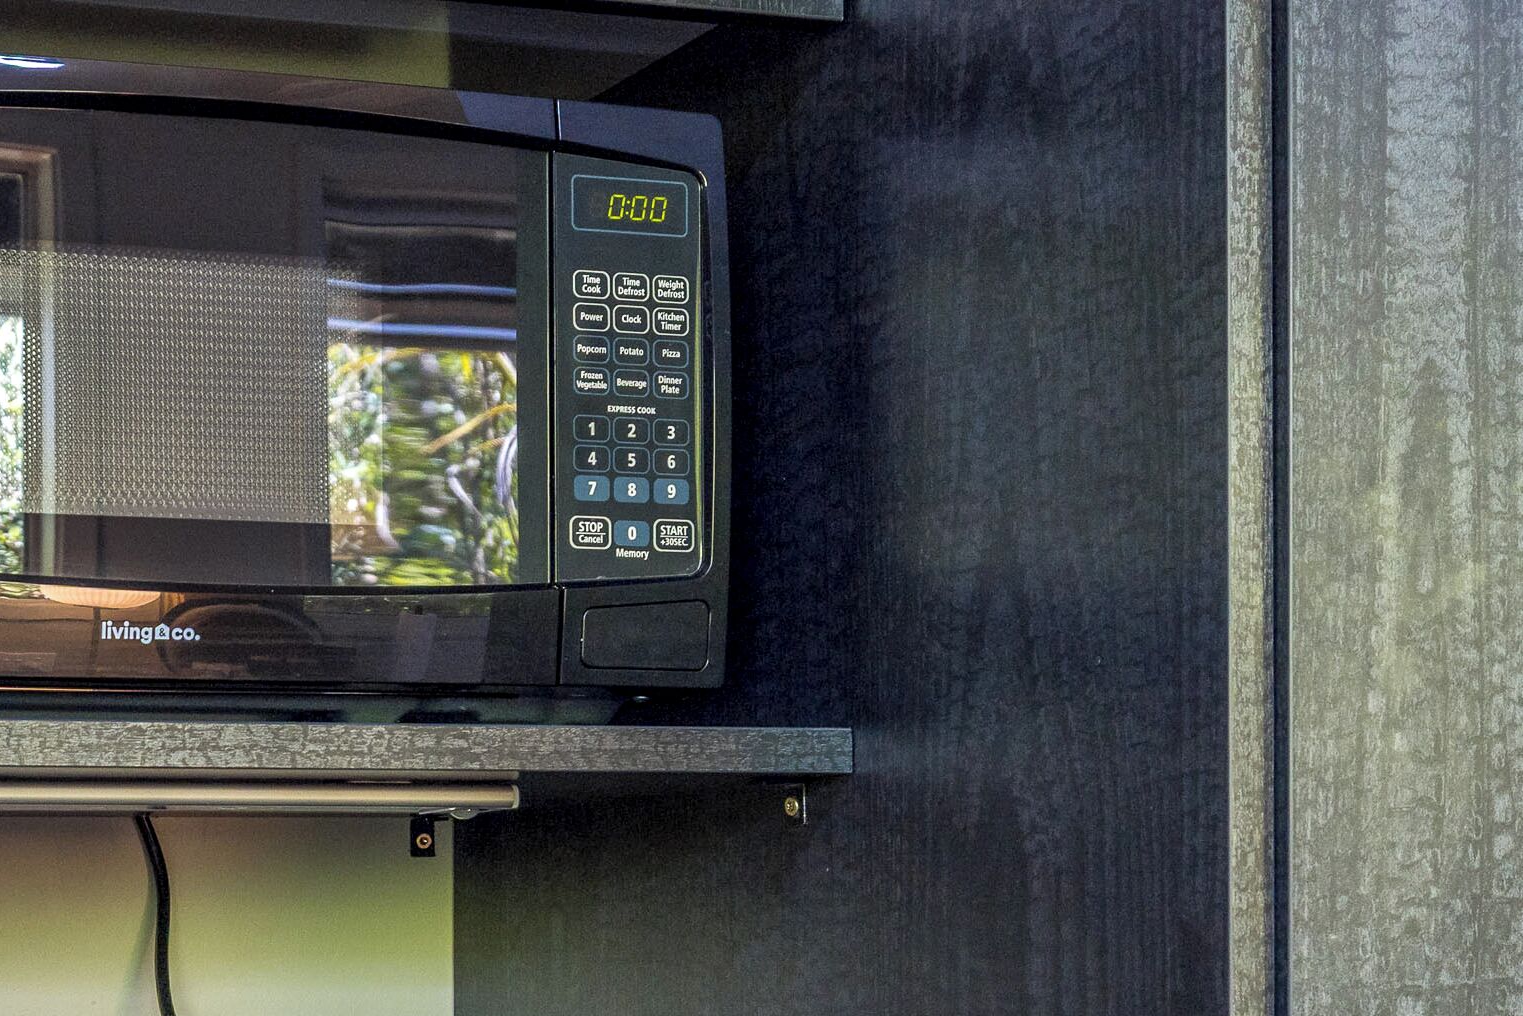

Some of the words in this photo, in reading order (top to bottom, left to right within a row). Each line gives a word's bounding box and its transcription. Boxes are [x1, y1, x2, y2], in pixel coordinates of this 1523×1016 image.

[608, 194, 668, 222] 0:00
[583, 274, 601, 284] Time
[622, 277, 641, 287] Time
[582, 284, 601, 294] Cook
[658, 280, 684, 291] Weight
[618, 286, 645, 297] Defrost
[657, 289, 685, 299] Defrost
[580, 312, 603, 321] Power
[621, 314, 642, 324] Clock
[657, 312, 685, 322] Kitchen
[660, 321, 682, 331] Timer
[577, 343, 607, 355] Popcorn
[619, 346, 644, 356] Potato
[662, 348, 681, 358] Pizza
[580, 370, 603, 380] Frozen
[658, 375, 683, 386] Dinner
[576, 380, 608, 390] Vegetable
[616, 378, 647, 390] Beverage
[661, 385, 680, 394] Plate
[607, 405, 636, 414] EXPRESS
[637, 406, 656, 415] COOK
[588, 422, 595, 436] 1
[627, 423, 636, 438] 2
[667, 425, 676, 440] 3
[588, 451, 597, 466] 4
[627, 453, 636, 467] 5
[667, 454, 676, 469] 6
[588, 481, 597, 495] 7
[627, 482, 637, 497] 8
[667, 484, 676, 499] 9
[578, 521, 604, 533] STOP
[660, 525, 689, 536] START
[578, 534, 603, 544] Cancel
[627, 526, 637, 541] 0
[616, 547, 650, 560] Memory
